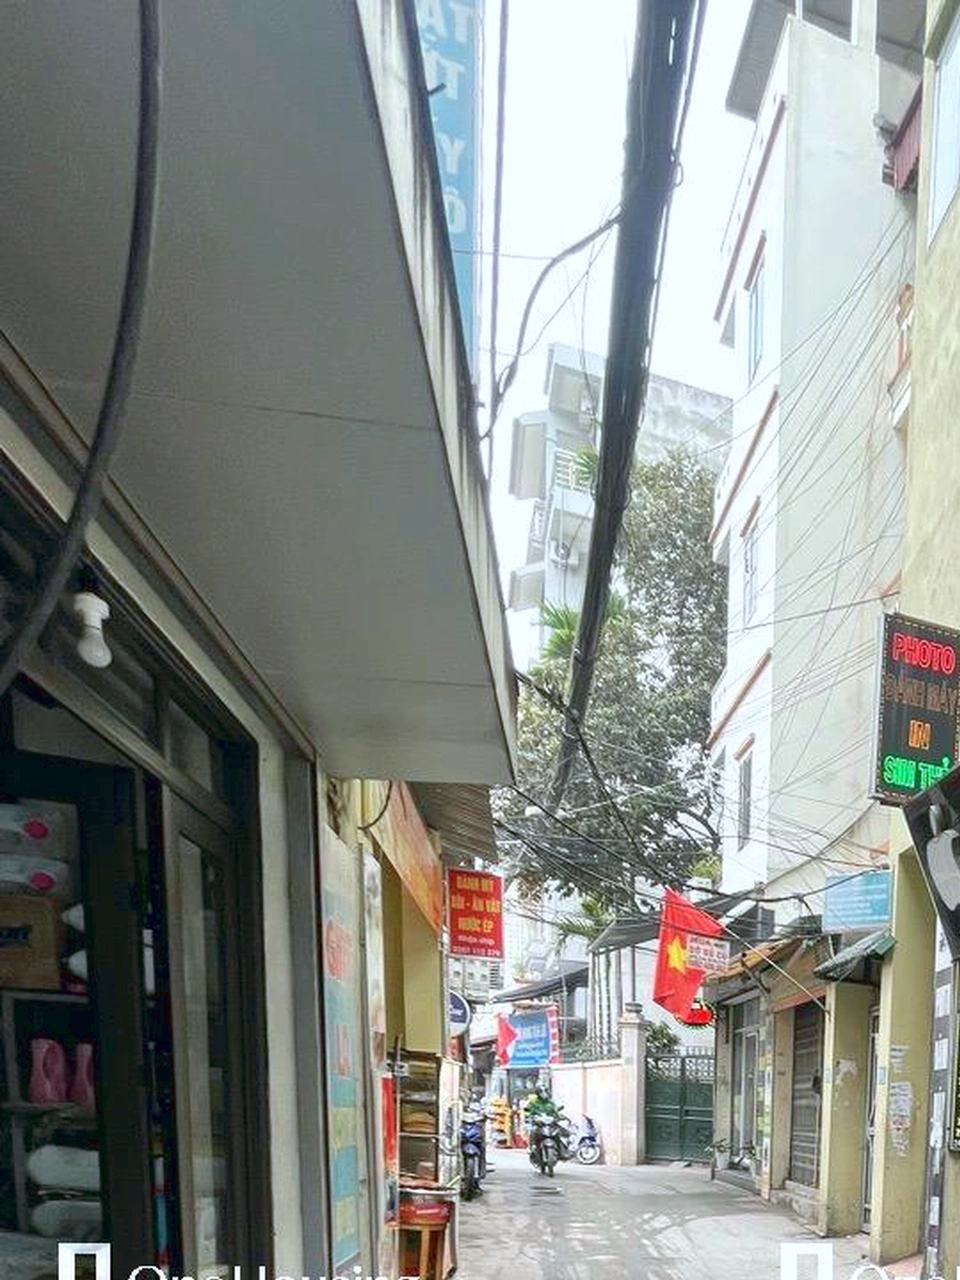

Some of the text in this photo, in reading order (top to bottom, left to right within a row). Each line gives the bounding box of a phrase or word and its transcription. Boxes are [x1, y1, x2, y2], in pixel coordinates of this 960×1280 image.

[892, 632, 956, 675] PHOTO
[908, 719, 931, 750] IN
[883, 755, 917, 789] SIM
